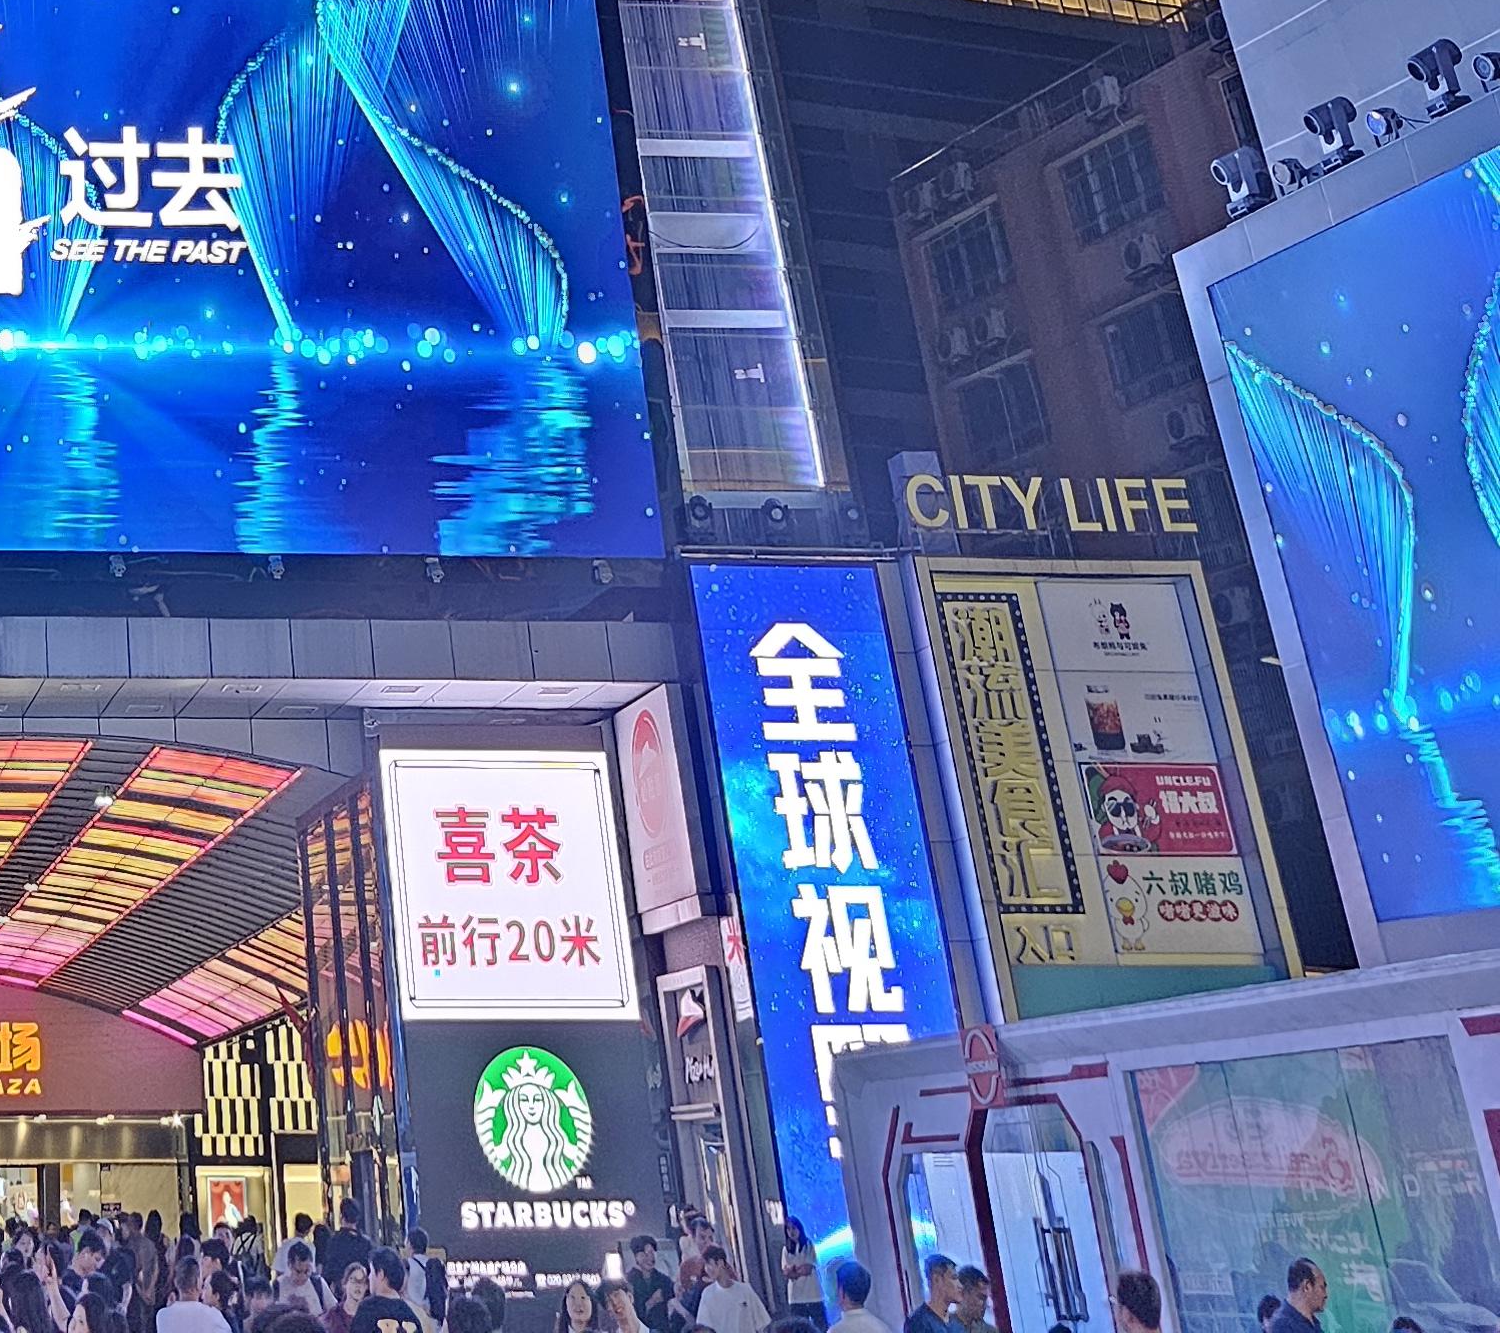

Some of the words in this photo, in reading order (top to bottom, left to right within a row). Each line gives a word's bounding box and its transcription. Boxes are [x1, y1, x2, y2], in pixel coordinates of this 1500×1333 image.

[59, 125, 243, 232] 过去
[50, 238, 107, 264] SEE
[112, 239, 173, 264] THE
[171, 240, 248, 265] PAST
[905, 473, 1046, 532] CITY
[1063, 478, 1199, 534] LIFE
[952, 606, 1063, 900] 潮流美食汇
[433, 806, 562, 887] 喜茶
[749, 622, 911, 1160] 全球视
[417, 913, 602, 969] 前行20米
[1015, 923, 1077, 965] 入口
[460, 1200, 627, 1230] STARBUCKS
